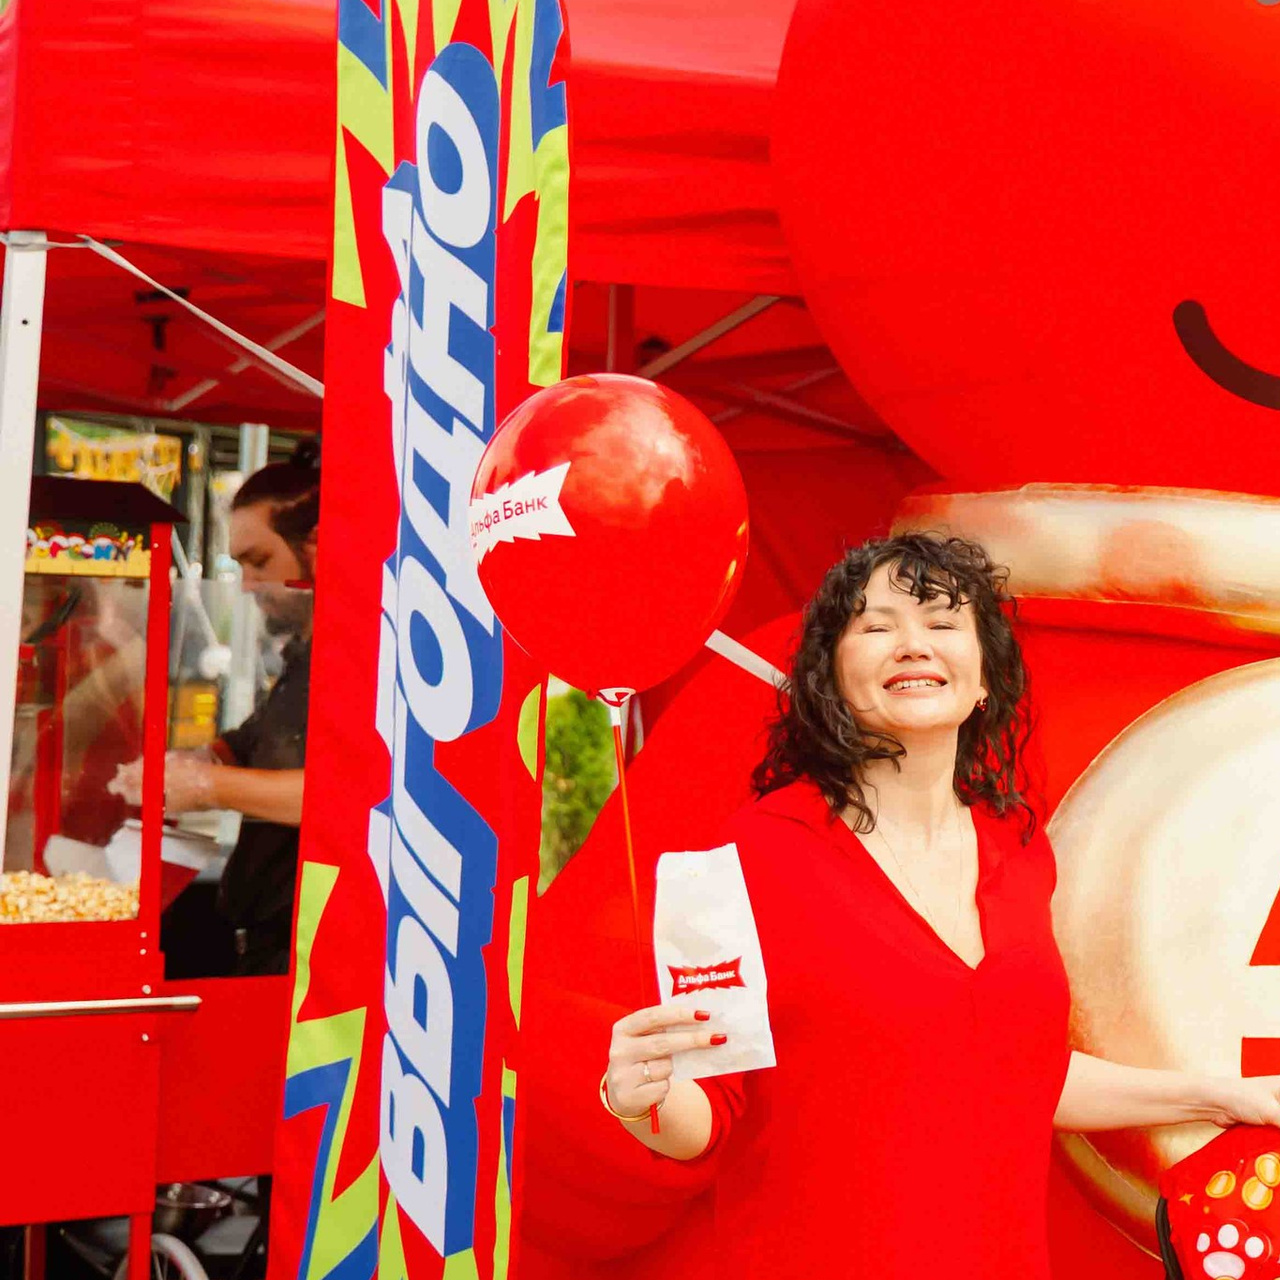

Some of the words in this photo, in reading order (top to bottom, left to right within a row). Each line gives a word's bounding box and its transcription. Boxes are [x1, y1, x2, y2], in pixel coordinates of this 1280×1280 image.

[503, 496, 548, 520] Банк
[380, 70, 491, 1259] ВЫГОДНО
[710, 969, 736, 982] Банк
